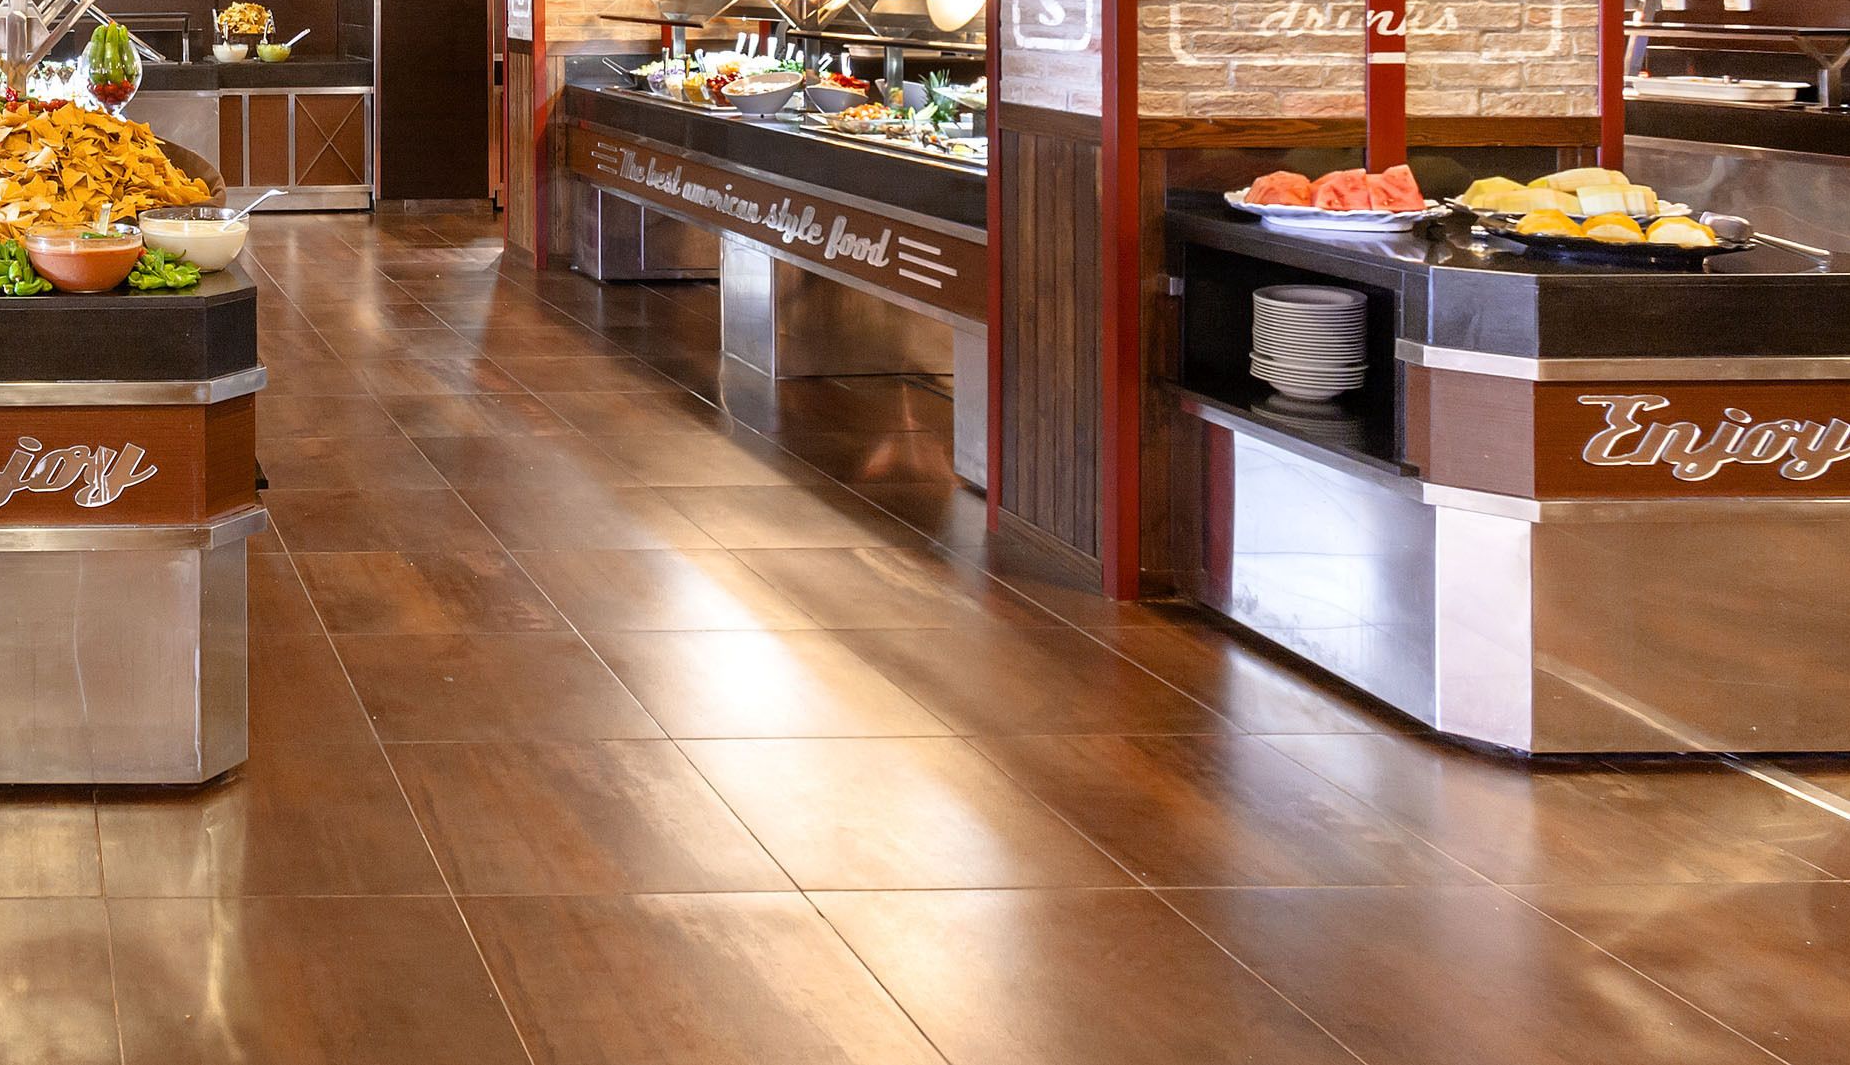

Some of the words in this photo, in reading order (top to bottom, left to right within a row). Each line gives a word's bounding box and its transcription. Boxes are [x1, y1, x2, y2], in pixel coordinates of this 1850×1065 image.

[619, 147, 646, 184] The
[645, 156, 682, 196] best
[681, 183, 763, 225] american
[761, 197, 825, 244] style
[823, 215, 893, 268] food
[1576, 394, 1850, 482] Enjoy
